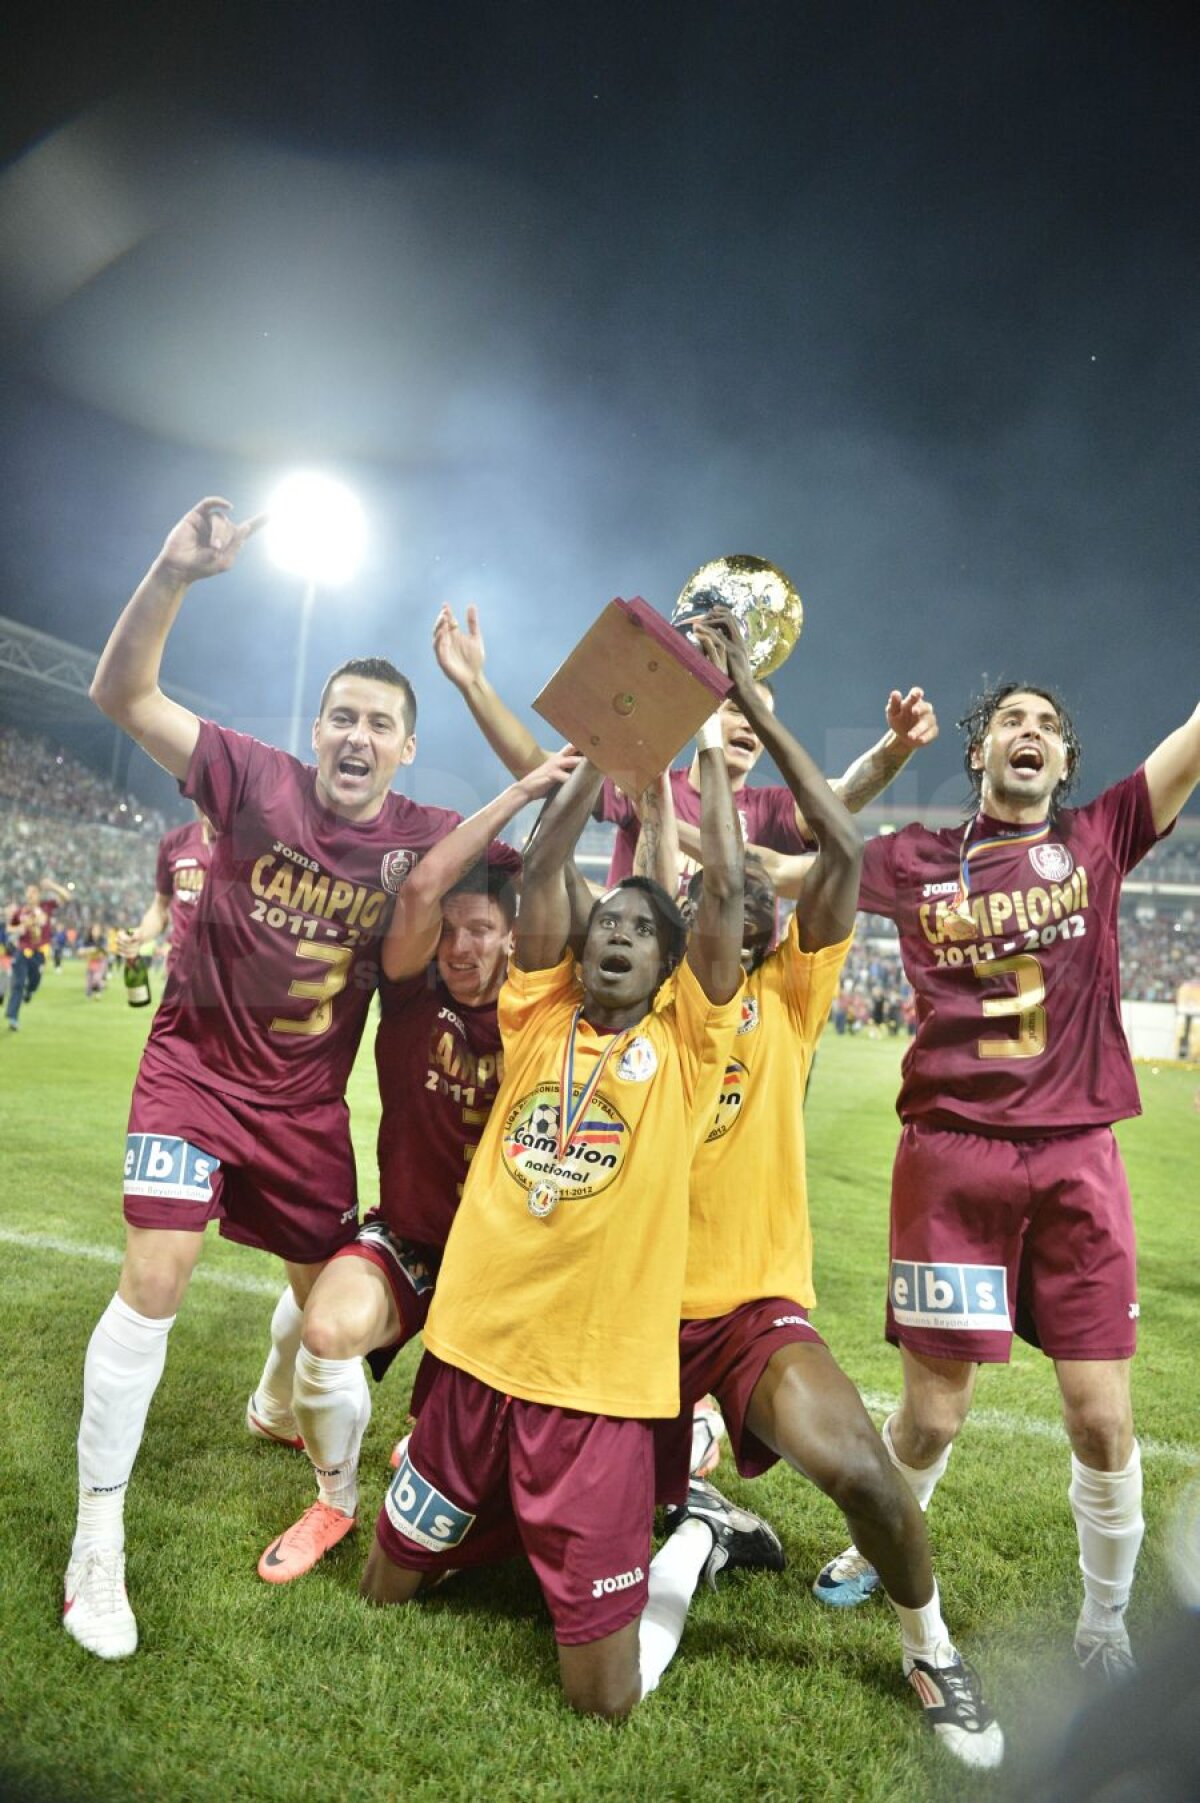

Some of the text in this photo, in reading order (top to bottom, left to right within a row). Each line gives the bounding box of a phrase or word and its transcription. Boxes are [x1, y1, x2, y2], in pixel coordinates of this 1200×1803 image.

[249, 899, 318, 940] 2011
[933, 942, 996, 968] 2011
[1023, 914, 1087, 951] 2012
[268, 940, 353, 1036] 3
[972, 954, 1047, 1059] 3
[524, 1159, 591, 1184] national
[893, 1269, 997, 1312] ebs
